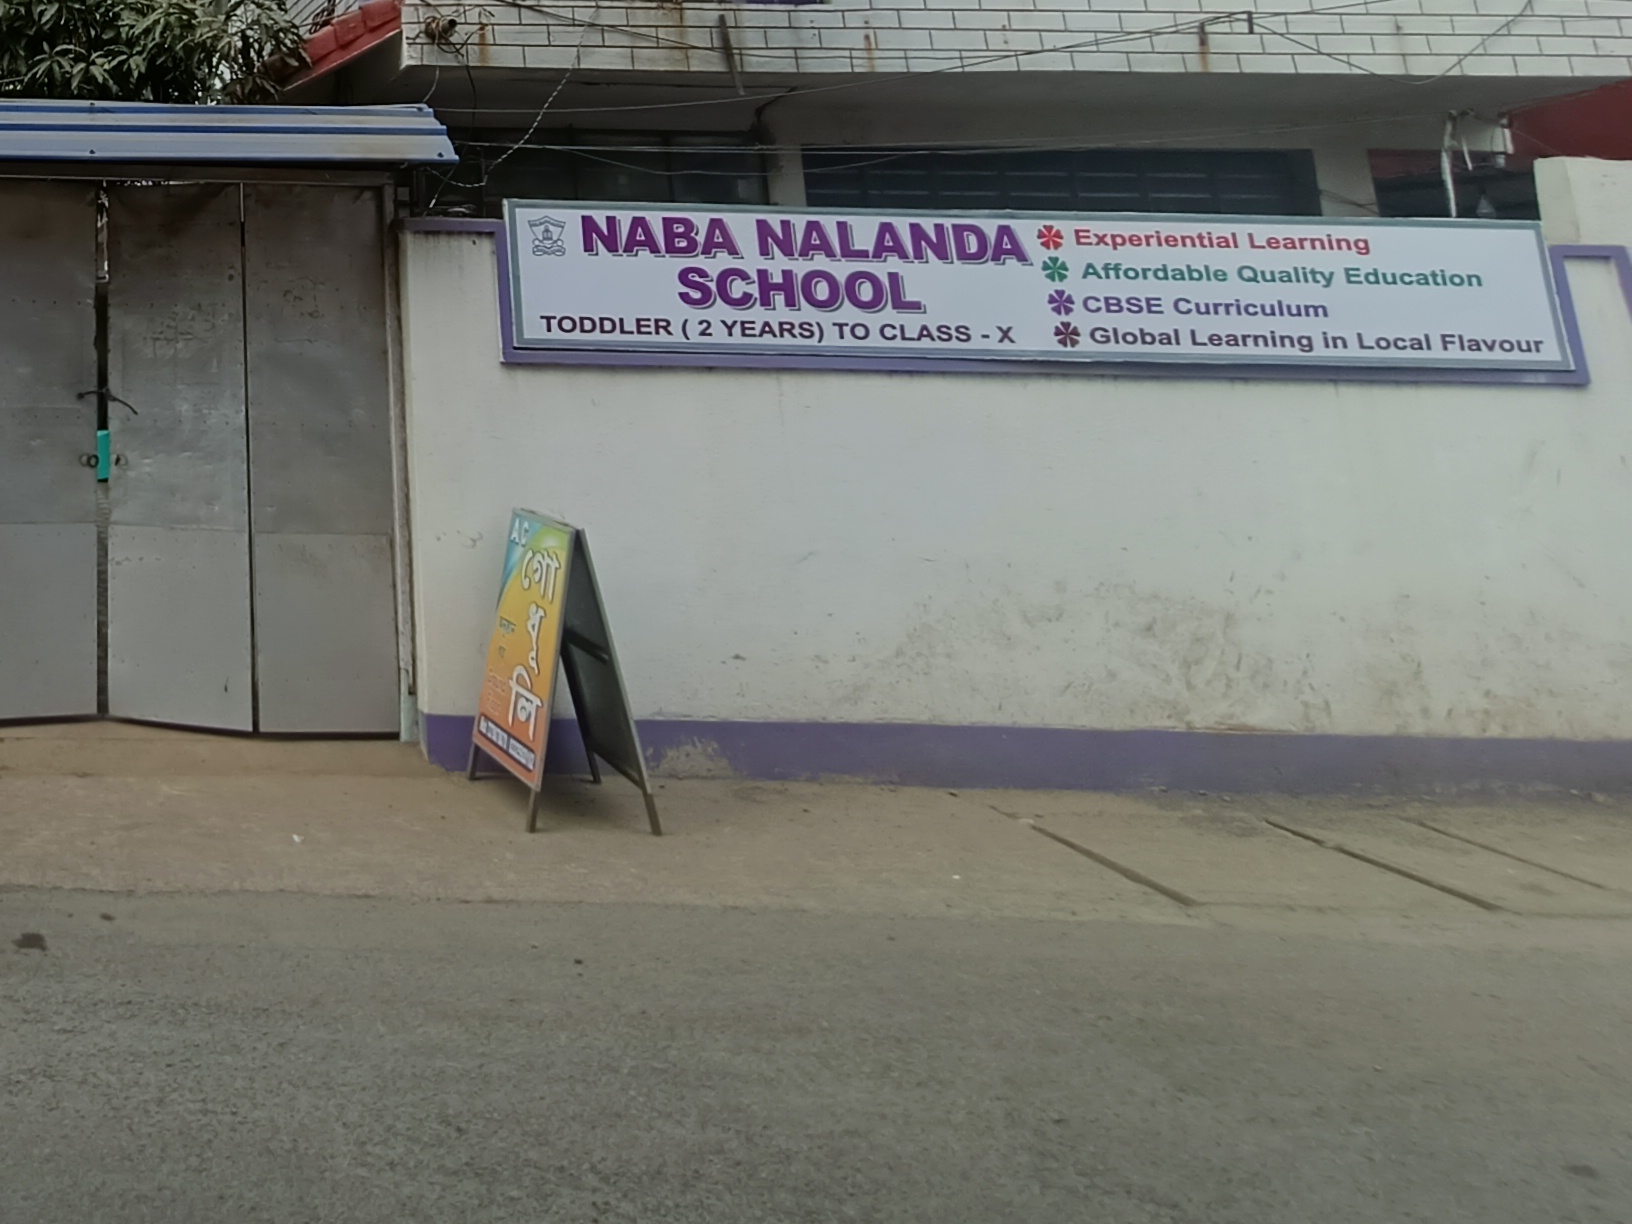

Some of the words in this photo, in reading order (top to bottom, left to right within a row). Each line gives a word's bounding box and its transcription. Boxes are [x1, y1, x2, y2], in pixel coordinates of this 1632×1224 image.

[581, 215, 743, 259] NABA
[756, 219, 1032, 264] NALANDA
[1074, 228, 1239, 251] Experiential
[1248, 232, 1370, 255] Learning
[1081, 262, 1228, 284] Affordable
[1237, 265, 1334, 288] Quality
[1346, 267, 1483, 287] Education
[677, 267, 926, 313] SCHOOL
[1083, 296, 1164, 315] CBSE
[1173, 297, 1329, 318] Curriculum
[540, 316, 671, 336] TODDLER
[698, 319, 712, 337] 2
[720, 320, 824, 343] YEARS)
[833, 322, 870, 340] TO
[878, 323, 971, 342] CLASS
[996, 325, 1016, 343] X
[1089, 326, 1181, 347] Global
[1191, 328, 1314, 353] Learning
[1322, 331, 1348, 349] in
[1357, 331, 1432, 351] Local
[1441, 334, 1544, 353] Flavour
